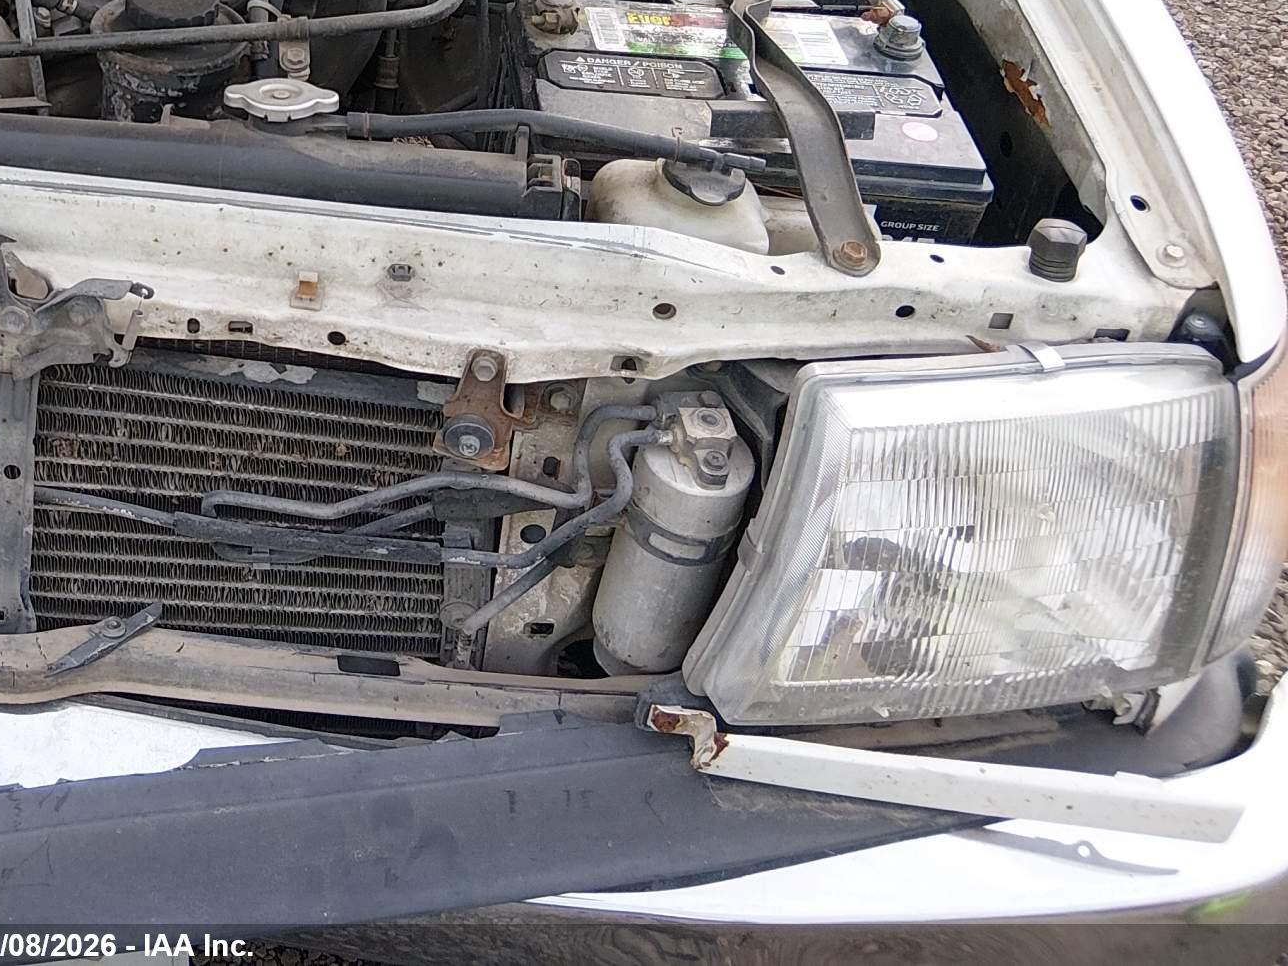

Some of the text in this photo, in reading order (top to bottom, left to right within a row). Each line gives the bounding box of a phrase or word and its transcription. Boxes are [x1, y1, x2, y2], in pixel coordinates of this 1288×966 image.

[587, 57, 631, 66] DANGER
[642, 61, 683, 69] POISON
[880, 220, 940, 231] GROUP SIZE
